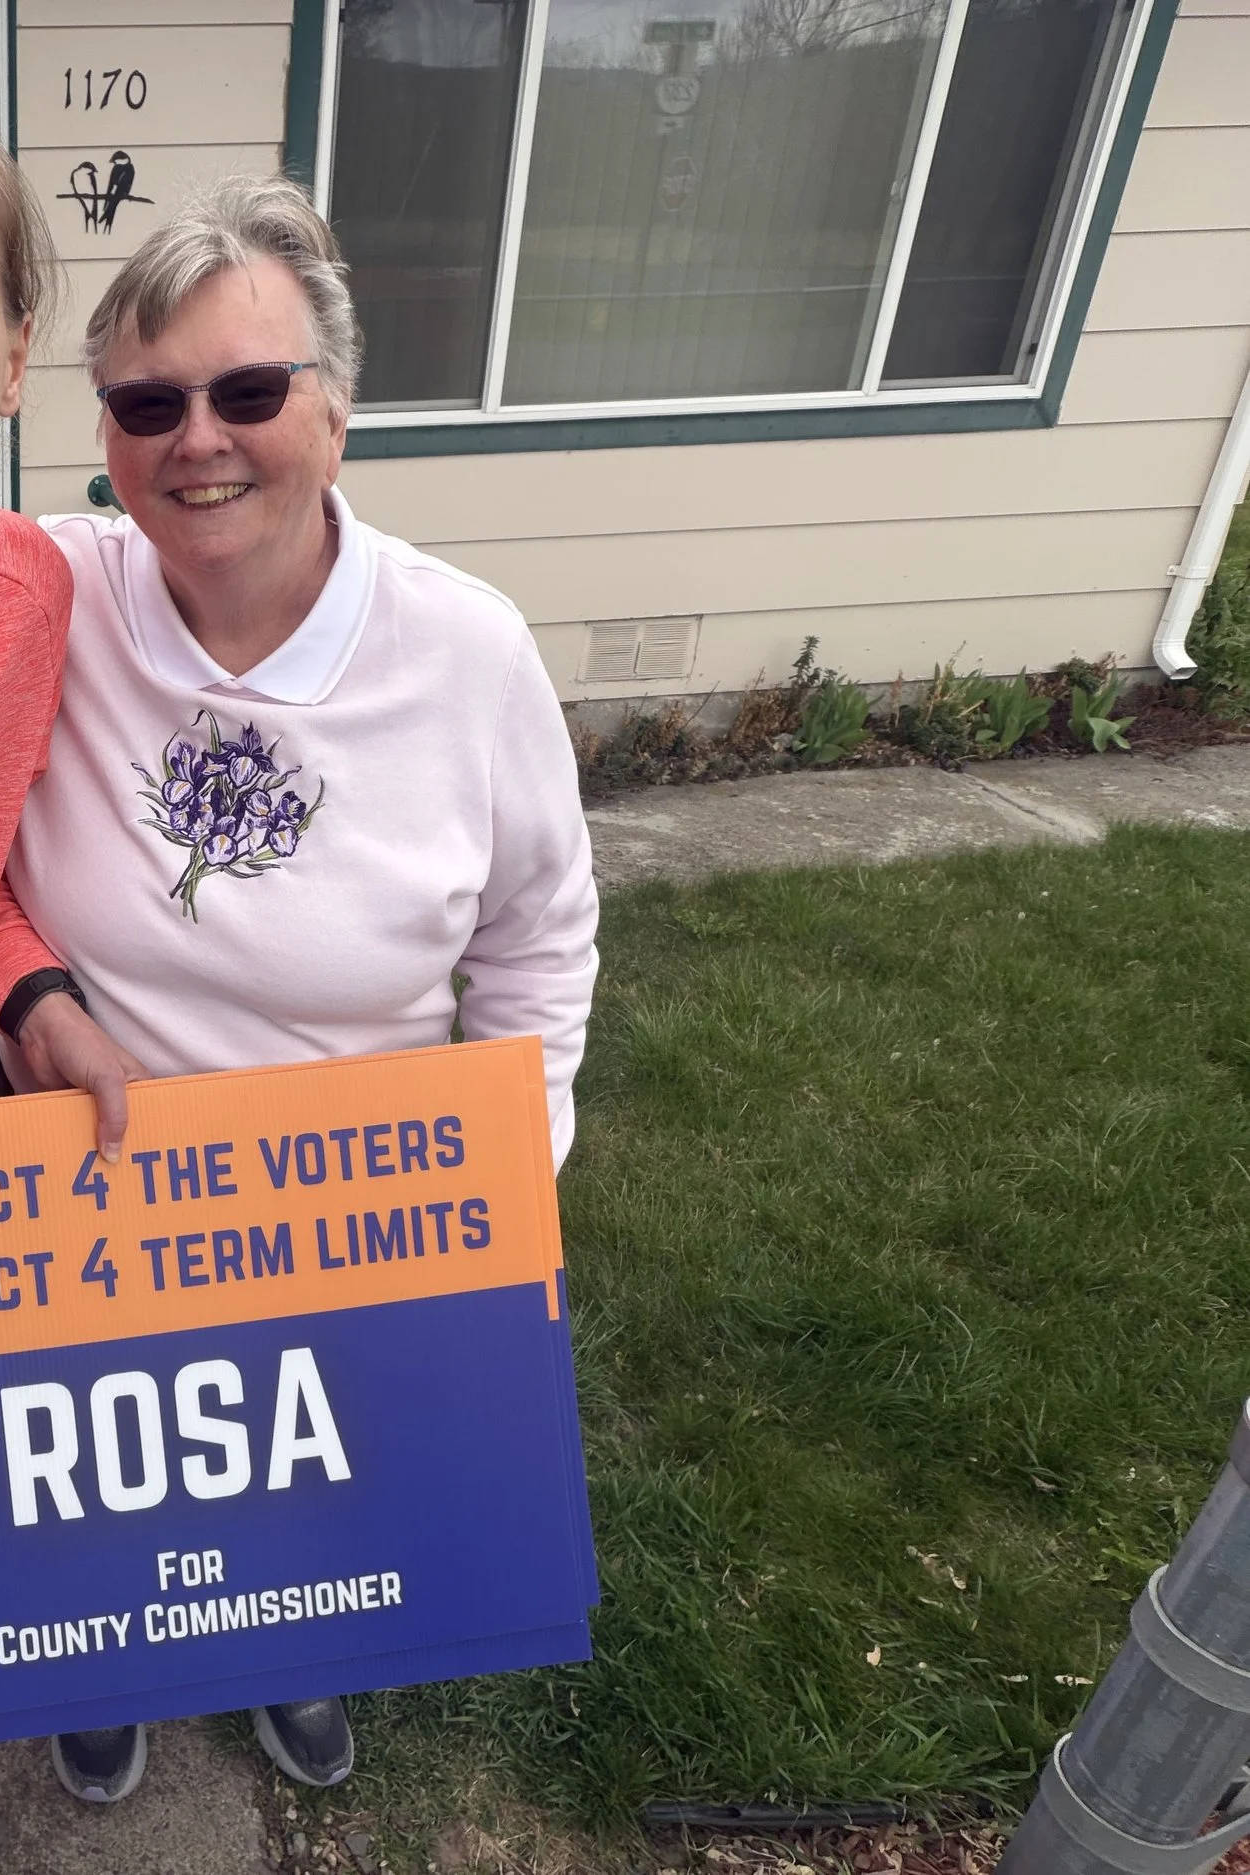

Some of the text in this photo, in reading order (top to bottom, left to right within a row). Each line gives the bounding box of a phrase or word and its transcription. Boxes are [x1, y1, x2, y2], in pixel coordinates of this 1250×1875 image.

[64, 67, 147, 111] 1170
[71, 1149, 110, 1211] 4
[131, 1141, 238, 1205] THE
[257, 1115, 465, 1189] VOTERS
[80, 1237, 119, 1298] 4
[140, 1222, 295, 1291] TERM
[315, 1197, 491, 1270] LIMITS
[0, 1347, 352, 1527] ROSA
[144, 1571, 403, 1643] COMMISSIONER
[157, 1549, 225, 1591] FOR
